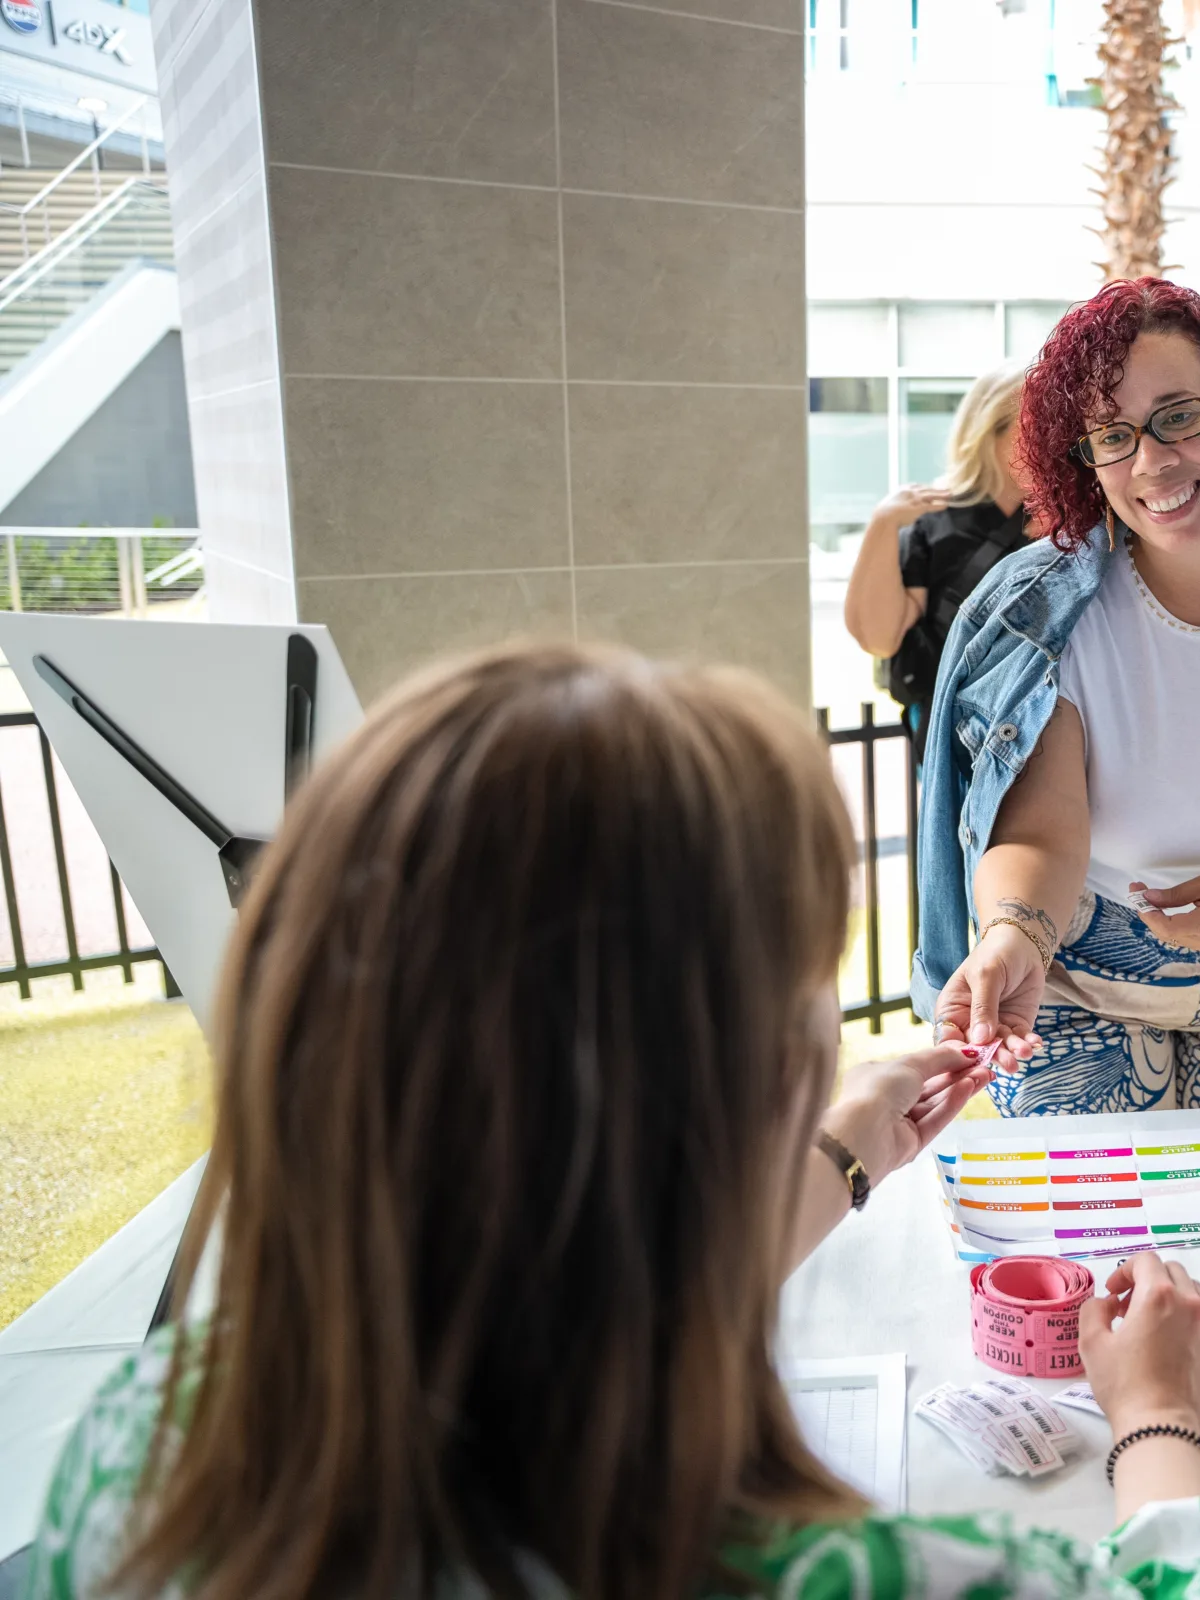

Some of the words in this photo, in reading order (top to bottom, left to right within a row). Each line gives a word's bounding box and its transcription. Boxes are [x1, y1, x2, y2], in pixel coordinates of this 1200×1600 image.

[1079, 1202, 1116, 1210] HELLO
[983, 1305, 1024, 1324] COUPON
[1047, 1316, 1079, 1327] UPON
[993, 1318, 1010, 1328] THIS
[988, 1324, 1016, 1338] KEEP
[1055, 1331, 1079, 1341] EEP
[985, 1343, 1024, 1367] TICKET
[1049, 1352, 1082, 1369] CKET
[1020, 1399, 1036, 1413] ONE
[1030, 1411, 1054, 1436] ADMIT
[1006, 1424, 1024, 1438] ONE
[1019, 1438, 1043, 1466] ADMIT
